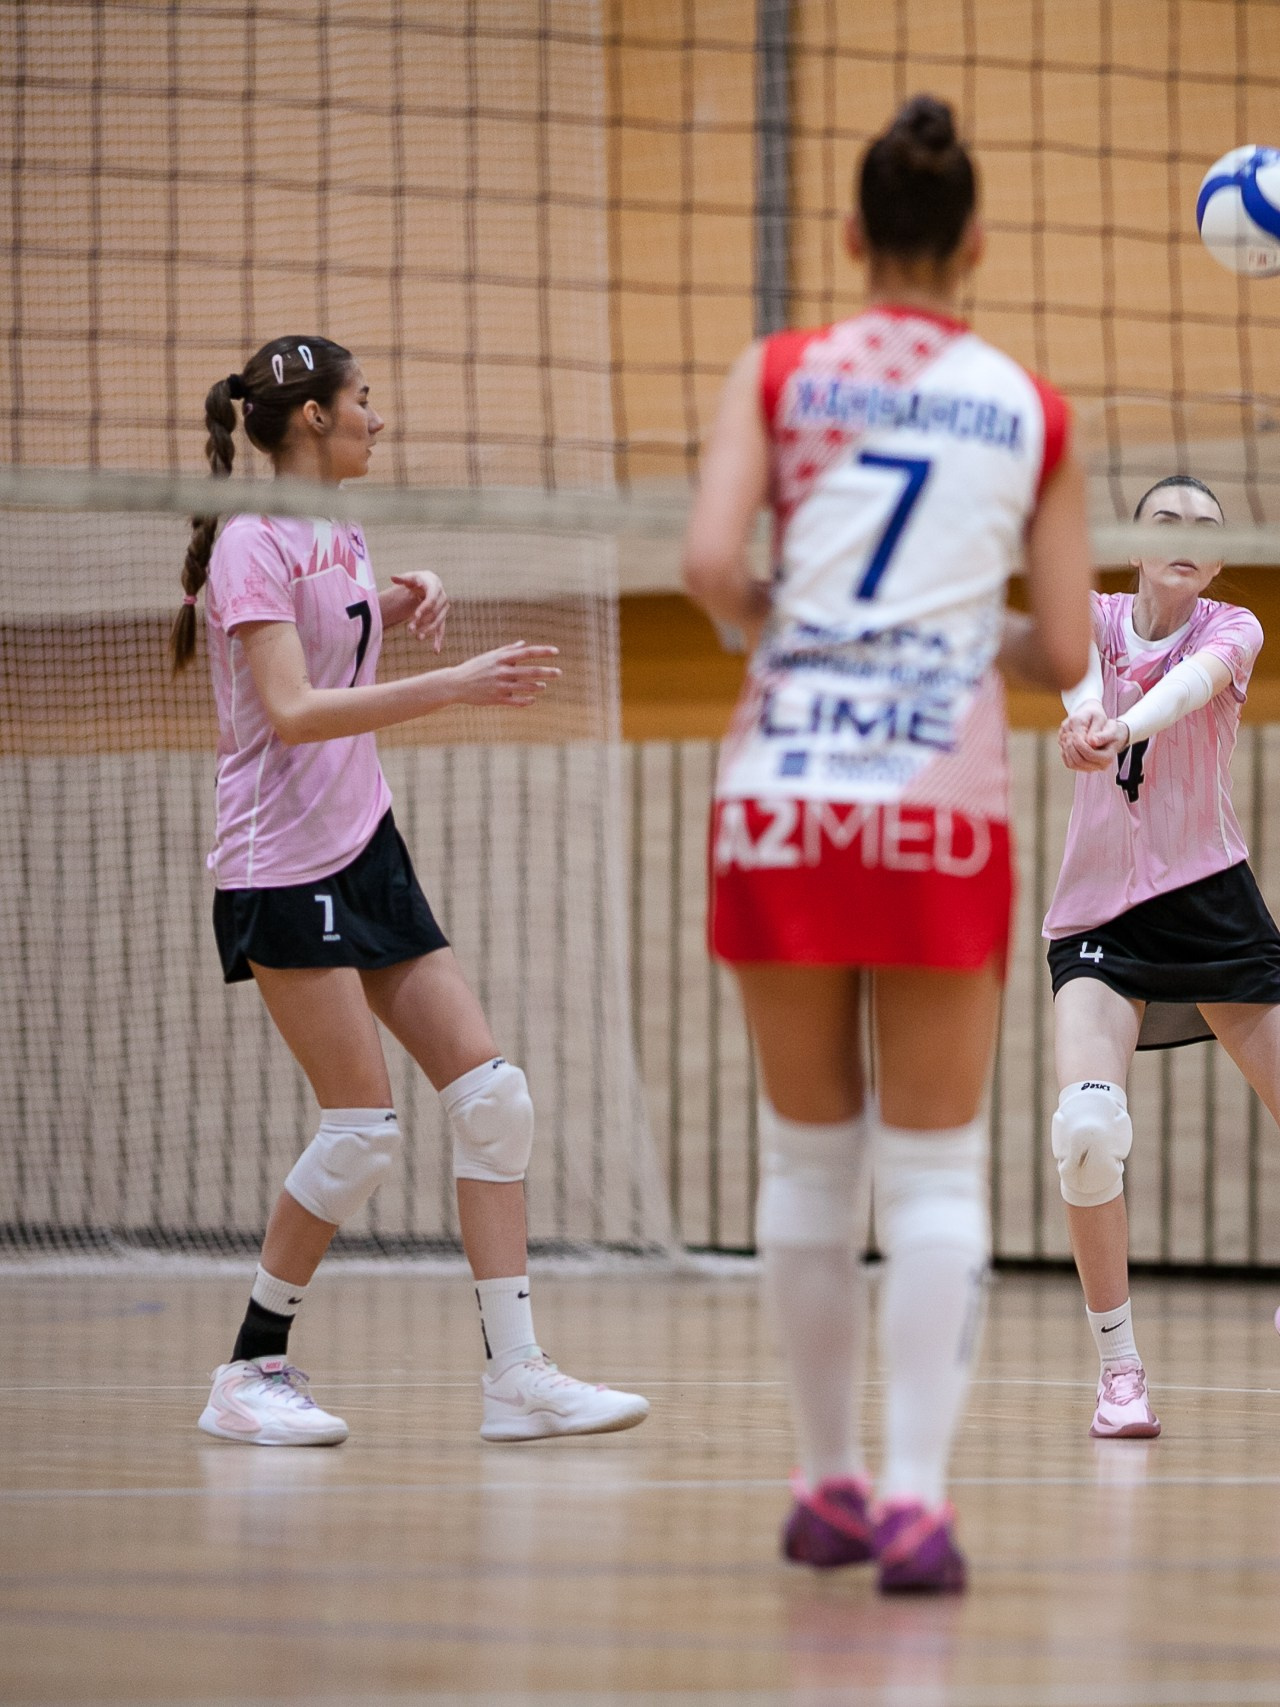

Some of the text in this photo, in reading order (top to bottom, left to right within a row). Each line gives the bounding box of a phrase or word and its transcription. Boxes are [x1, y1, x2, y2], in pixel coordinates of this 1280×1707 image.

[856, 451, 932, 603] 7
[345, 600, 372, 688] 7
[759, 688, 956, 755] LIME
[1079, 941, 1104, 963] 4
